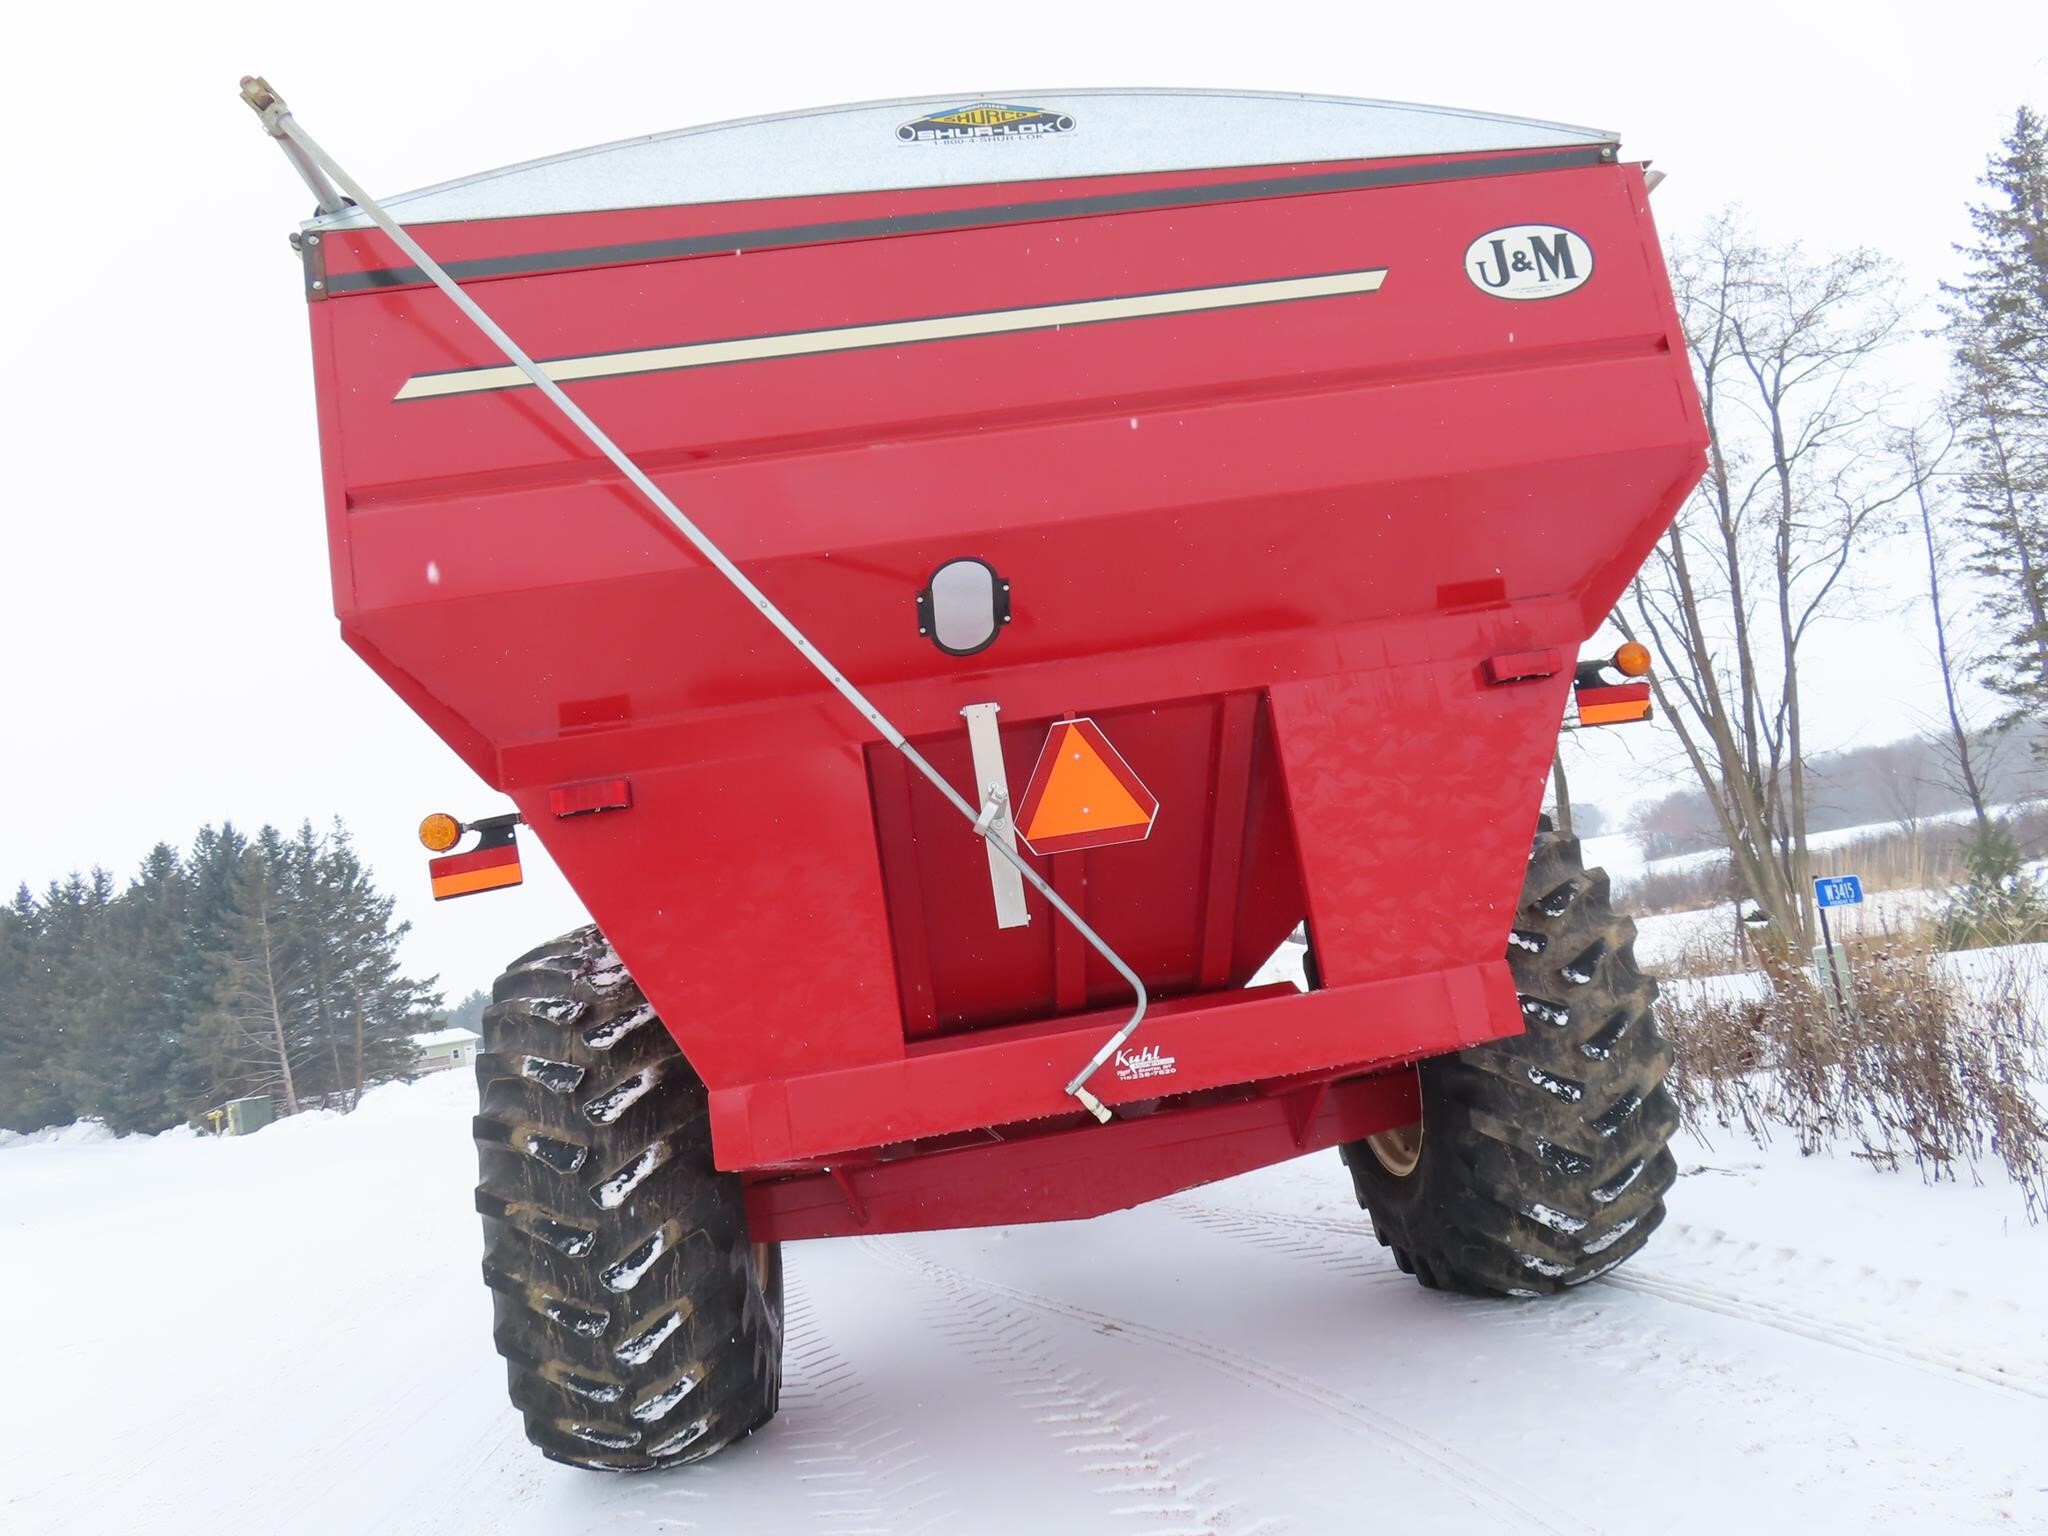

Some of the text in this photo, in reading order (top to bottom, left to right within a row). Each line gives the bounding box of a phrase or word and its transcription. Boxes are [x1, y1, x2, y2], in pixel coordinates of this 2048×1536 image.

[943, 108, 1028, 125] SHURCO
[917, 121, 1057, 141] SHUR-LOK
[1475, 233, 1579, 288] J&M
[1115, 1045, 1160, 1067] Kuhl
